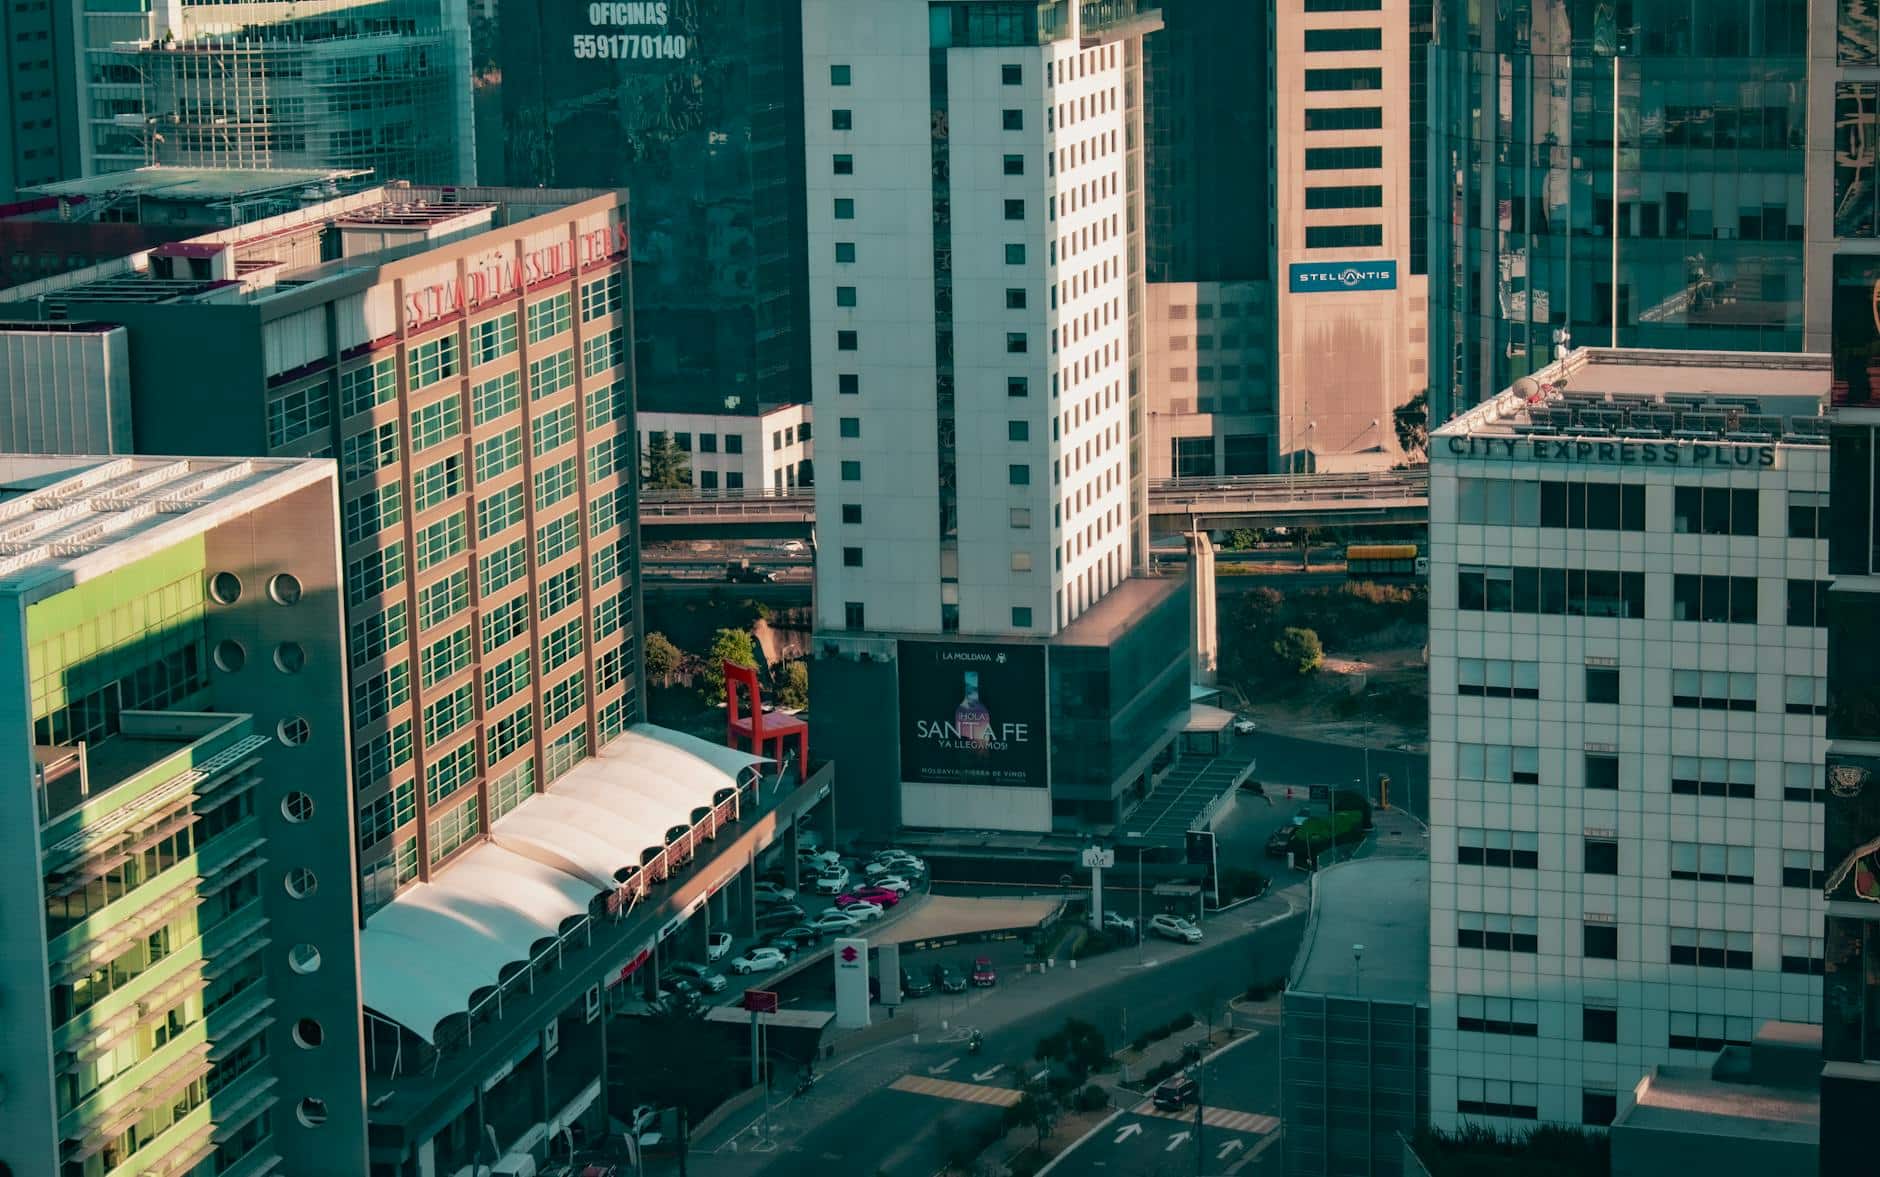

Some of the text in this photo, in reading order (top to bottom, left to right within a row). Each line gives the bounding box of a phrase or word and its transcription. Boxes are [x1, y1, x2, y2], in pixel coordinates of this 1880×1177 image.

[589, 2, 667, 26] OFICINAS
[573, 34, 686, 59] 5591770140
[1300, 269, 1390, 284] STELLANTIS
[1449, 435, 1775, 467] CITY EXPRESS PLUS
[917, 720, 1028, 742] SANTA FE
[938, 740, 952, 748] YA
